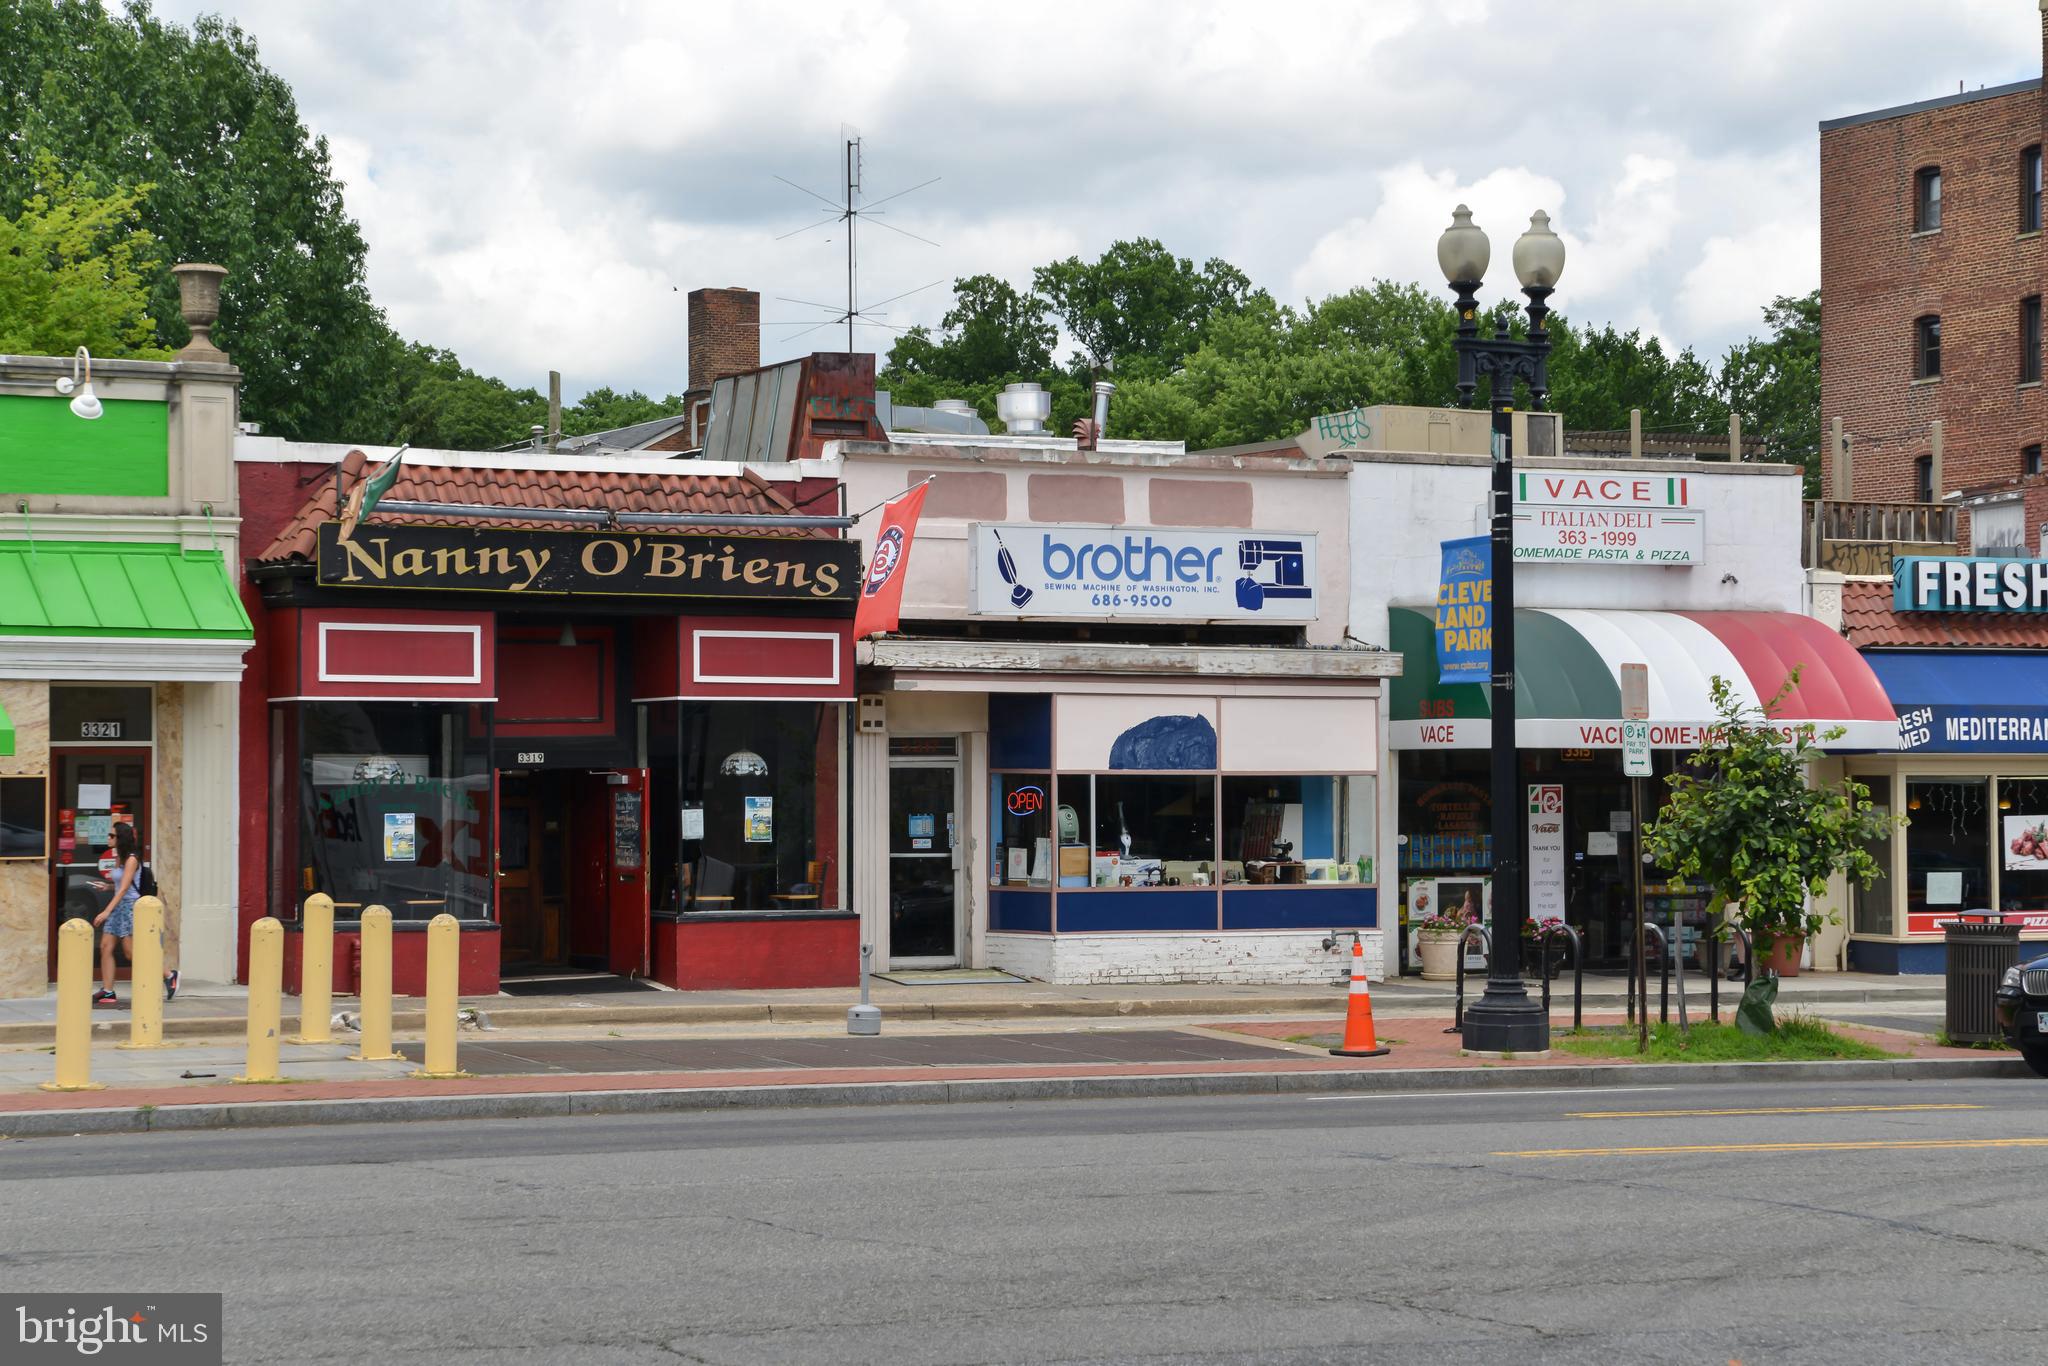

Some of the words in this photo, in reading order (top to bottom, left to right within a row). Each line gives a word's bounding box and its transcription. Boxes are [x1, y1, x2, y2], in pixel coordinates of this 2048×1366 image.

[1544, 478, 1651, 501] VACE
[1541, 511, 1609, 527] ITALIAN
[1615, 513, 1653, 528] DELI
[1043, 534, 1223, 583] brother
[1513, 548, 1582, 559] OMEMADE
[1588, 550, 1629, 560] PASTA
[1636, 550, 1645, 560] &
[1651, 551, 1690, 561] PIZZA
[340, 538, 551, 591] Nanny
[581, 539, 839, 596] O'Briens
[1045, 583, 1077, 591] SEWING
[1083, 583, 1121, 591] MACHINE
[1438, 579, 1493, 605] CLEVE
[1091, 594, 1173, 607] 686-9500
[1435, 605, 1486, 630] LAND
[1444, 627, 1493, 653] PARK
[1420, 699, 1454, 717] SUBS
[82, 722, 119, 737] 3321
[1420, 725, 1454, 743] VACE
[1899, 728, 1930, 750] MED
[518, 753, 544, 763] 3319
[1008, 792, 1043, 810] OPEN
